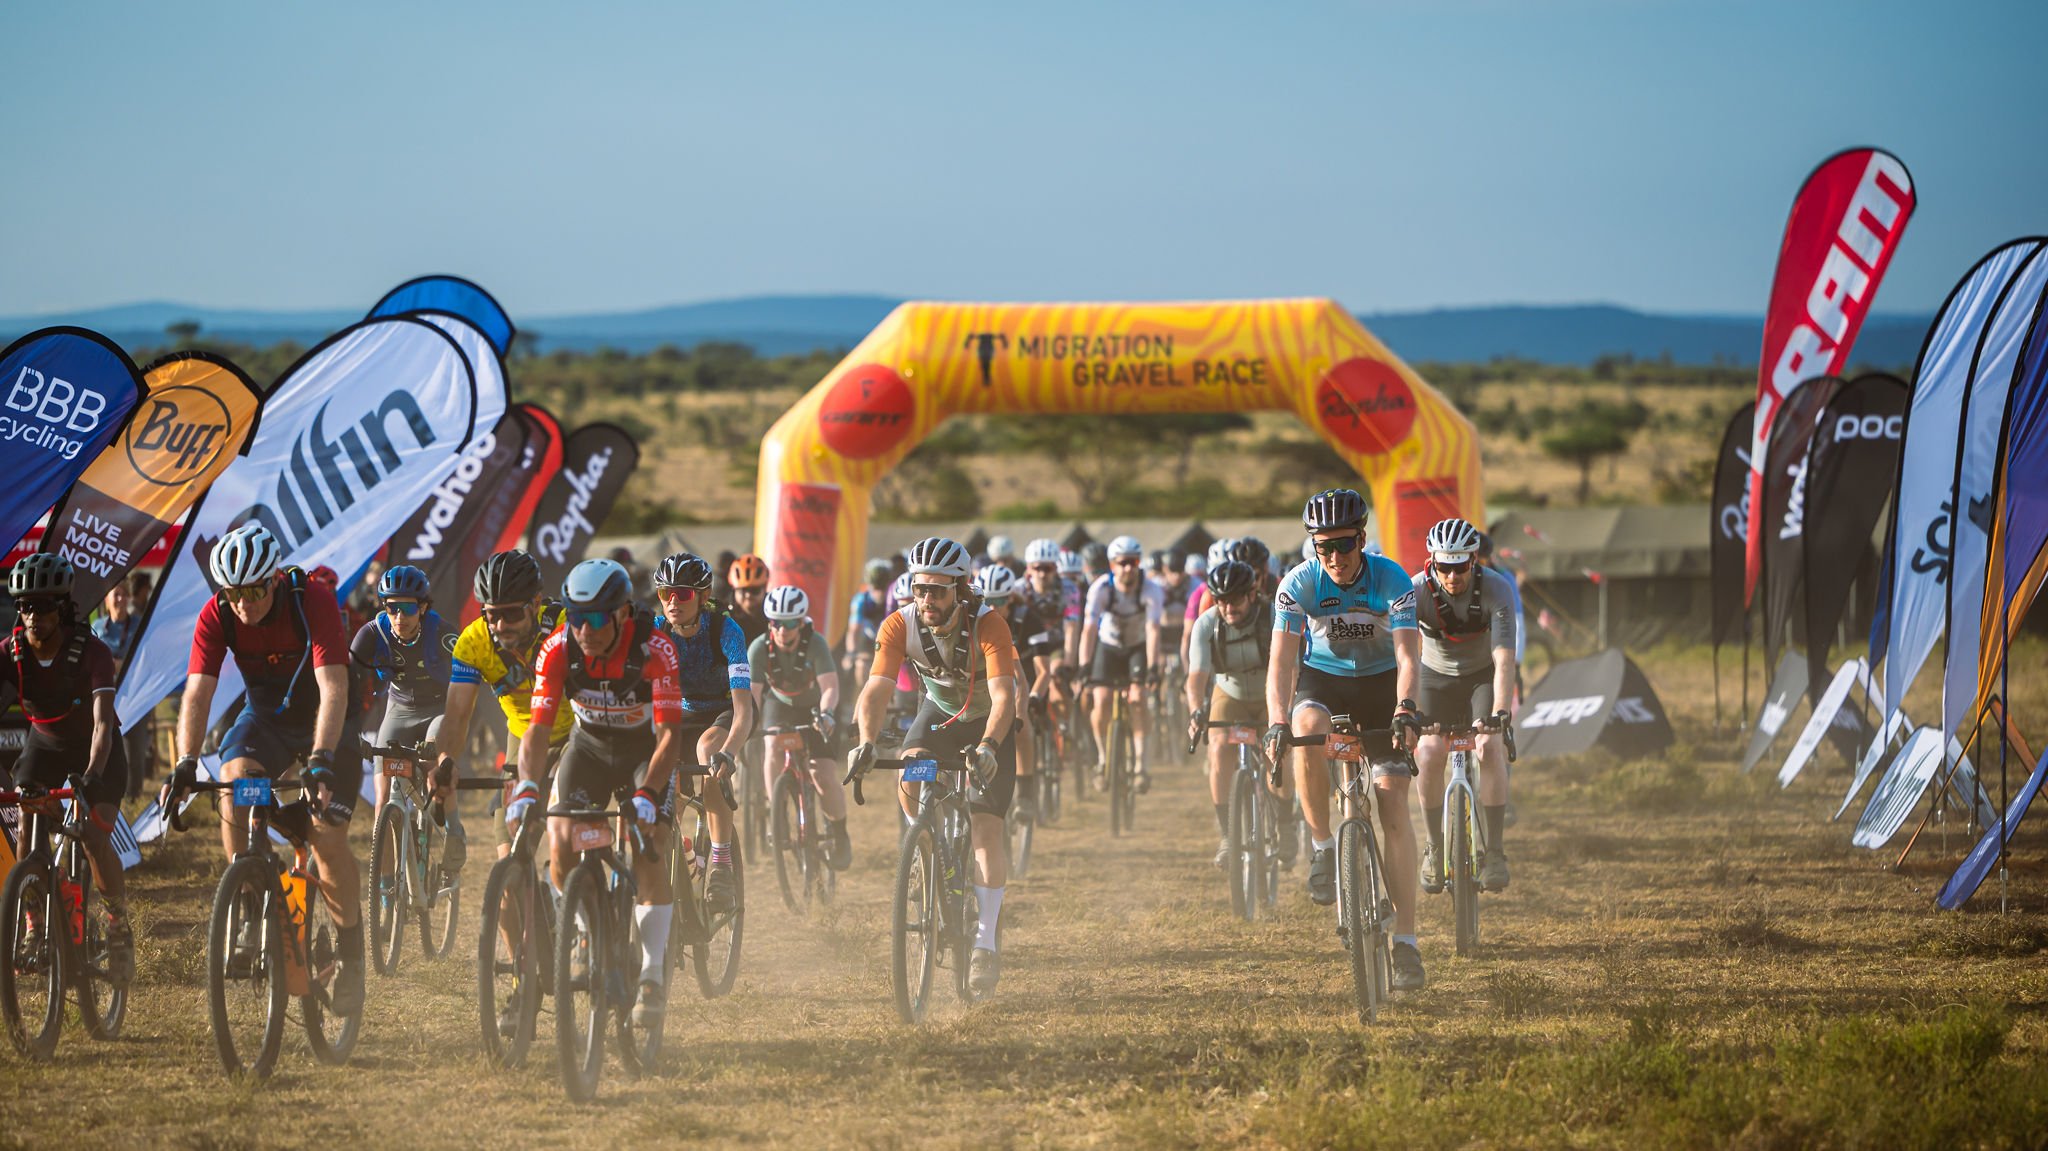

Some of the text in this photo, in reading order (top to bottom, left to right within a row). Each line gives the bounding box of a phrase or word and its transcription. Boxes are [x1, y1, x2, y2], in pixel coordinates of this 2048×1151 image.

[1018, 334, 1173, 360] MIGRATION
[1072, 359, 1267, 387] GRAVEL RACE
[5, 366, 106, 432] BBB
[0, 416, 83, 460] cycling
[408, 433, 496, 560] wahoo
[72, 508, 122, 542] LIVE
[59, 543, 113, 579] NOW
[65, 525, 131, 567] MORE
[1331, 617, 1346, 625] LA
[1332, 624, 1374, 632] FAUSTO
[912, 766, 928, 774] 207
